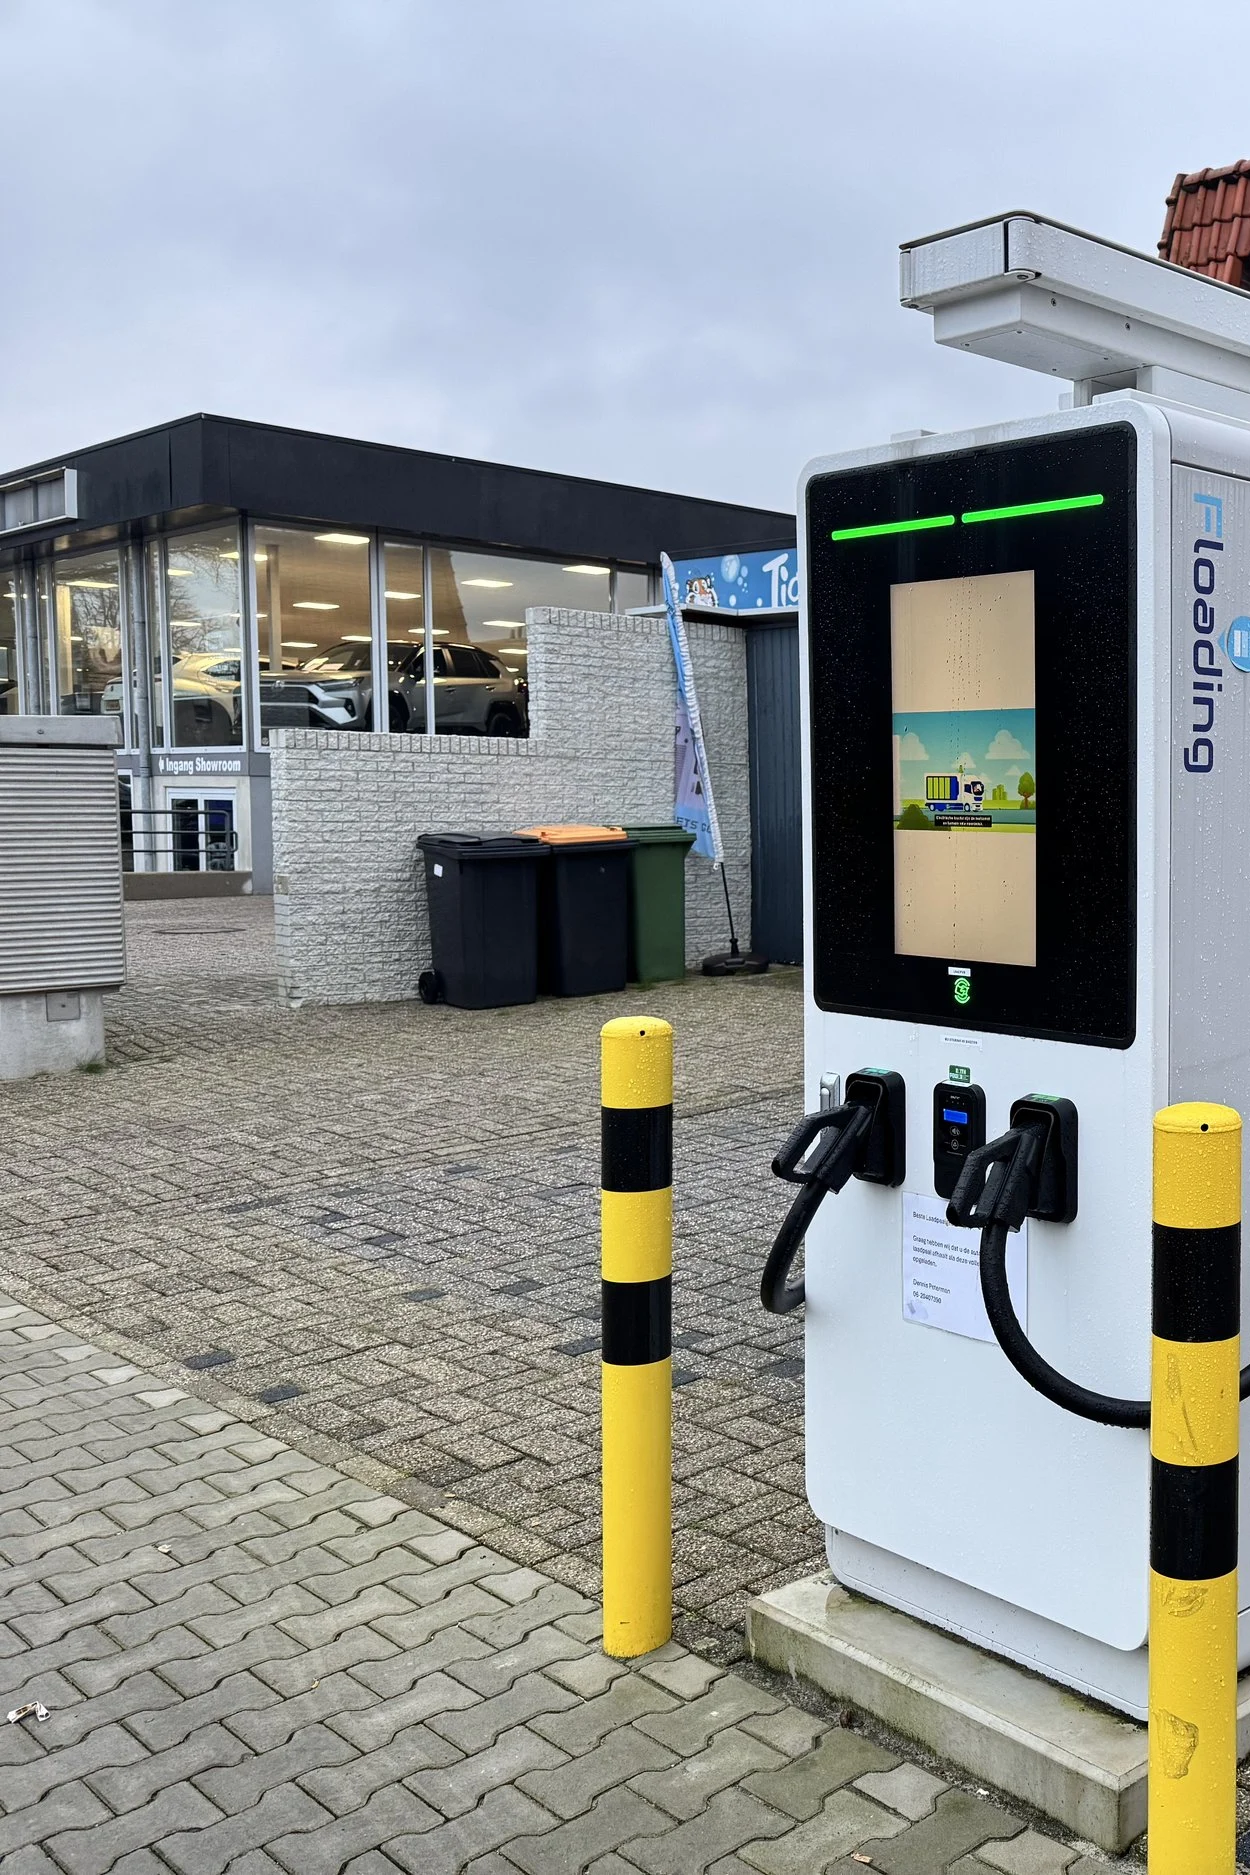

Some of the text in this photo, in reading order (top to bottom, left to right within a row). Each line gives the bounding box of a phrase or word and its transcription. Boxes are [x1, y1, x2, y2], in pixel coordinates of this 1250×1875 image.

[1183, 491, 1224, 774] Floading
[166, 757, 241, 775] Ingang Showroom
[676, 816, 699, 829] ETS
